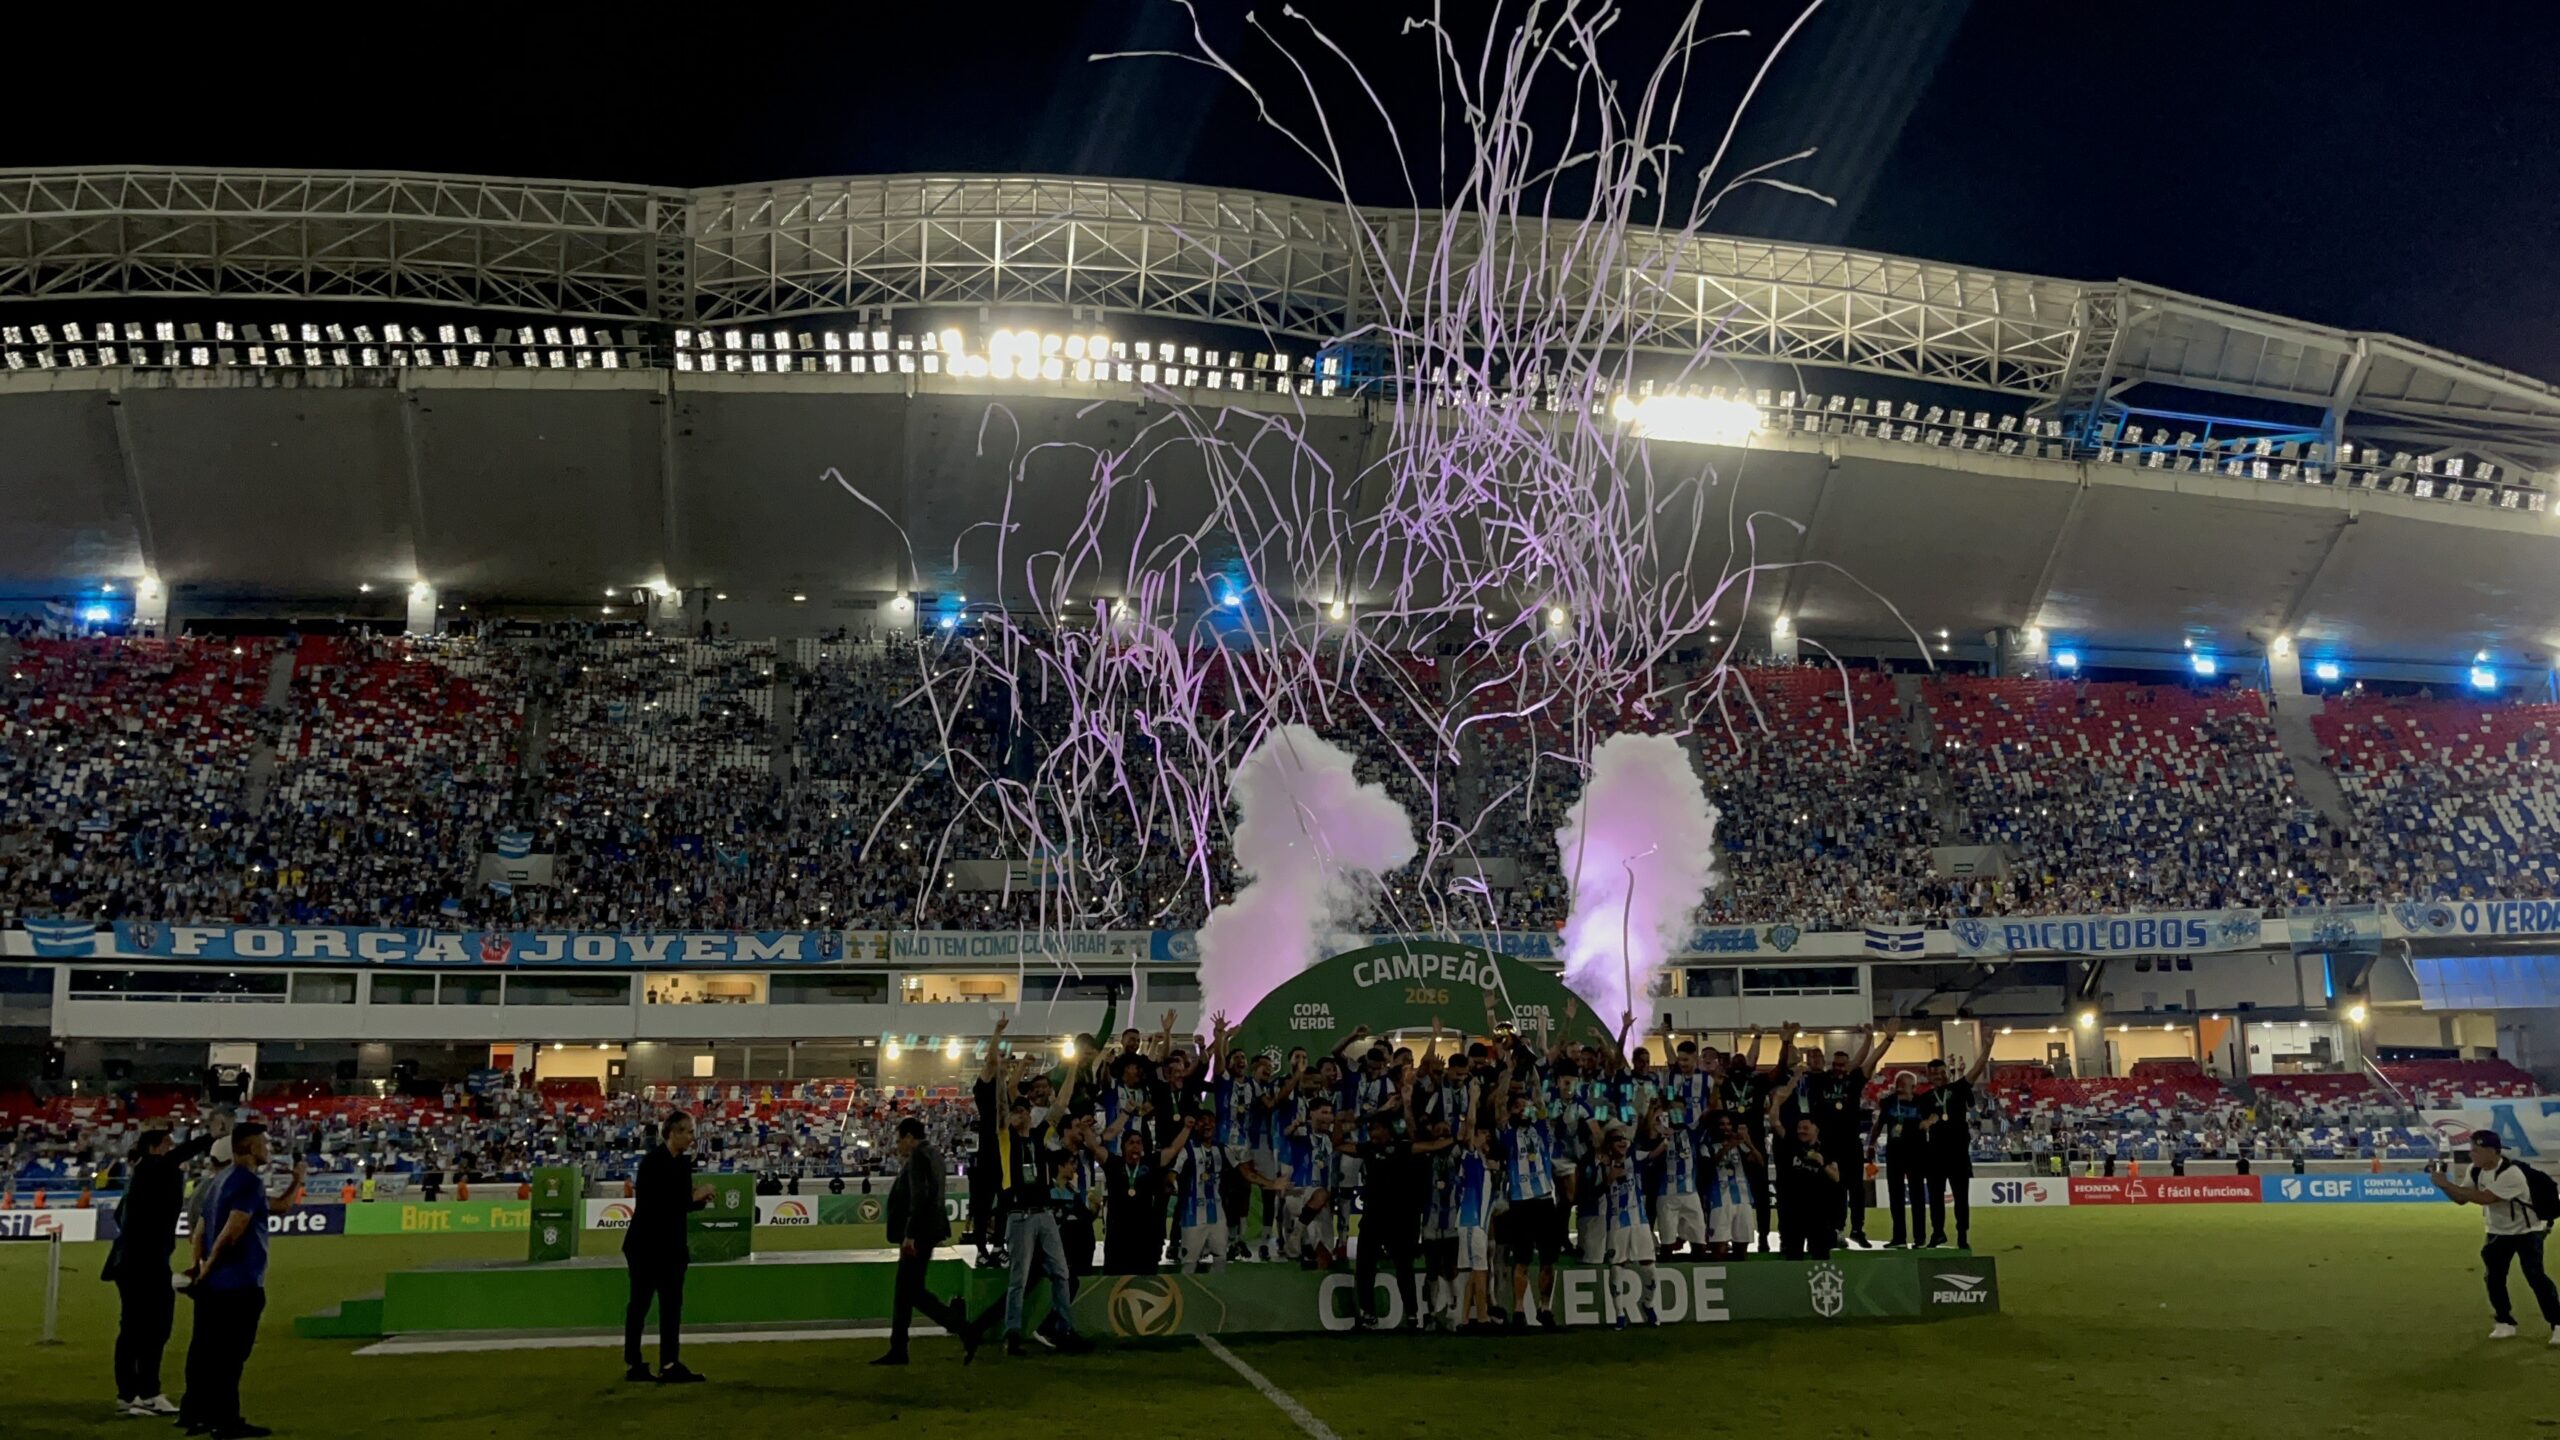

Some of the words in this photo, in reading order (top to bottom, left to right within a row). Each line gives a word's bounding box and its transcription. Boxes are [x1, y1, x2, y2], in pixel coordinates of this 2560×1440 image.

[2461, 902, 2479, 933] O
[169, 927, 471, 963] FORÇA
[519, 934, 804, 962] JOVEM
[895, 933, 930, 957] NÃO
[934, 937, 967, 957] TEM
[971, 934, 1021, 957] COMO
[1353, 951, 1500, 990] CAMPEÃO
[1404, 987, 1449, 1005] 2026
[1293, 1003, 1330, 1016] COPA
[1515, 1004, 1550, 1017] COPA
[1289, 1016, 1335, 1030] VERDE
[1510, 1017, 1555, 1031] ERE
[2074, 1184, 2121, 1193] HONDA
[2309, 1180, 2352, 1198] CBF
[2363, 1178, 2401, 1188] CONTRA
[2403, 1178, 2413, 1187] A
[1991, 1181, 2022, 1204] Sil
[2157, 1184, 2166, 1198] É
[2167, 1185, 2190, 1198] fácil
[2193, 1188, 2201, 1197] e
[2202, 1185, 2253, 1198] funciona.
[2364, 1185, 2435, 1197] MANIPULAÇÃO
[597, 1219, 632, 1228] Auror
[770, 1215, 810, 1226] Aurora
[1932, 1290, 1987, 1304] PENALTY
